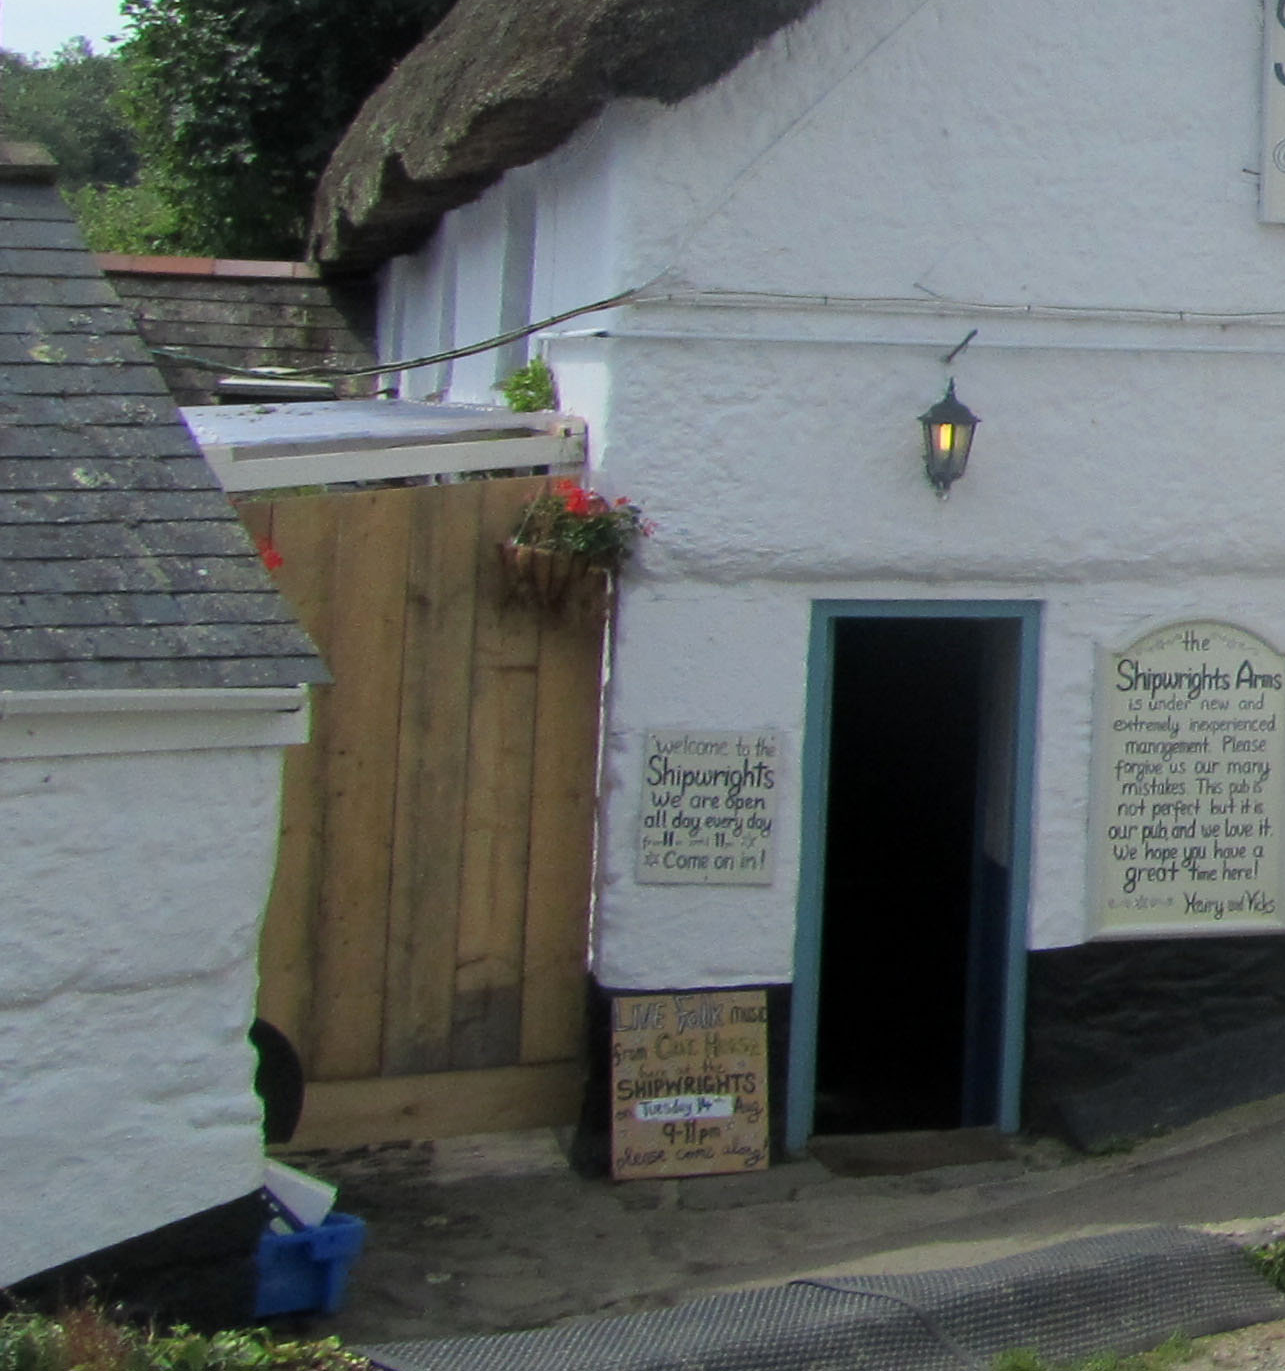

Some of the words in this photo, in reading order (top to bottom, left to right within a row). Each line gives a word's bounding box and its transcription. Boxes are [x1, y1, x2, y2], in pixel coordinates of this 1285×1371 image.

[1182, 630, 1211, 652] the
[1116, 658, 1231, 700] Shipwrights
[1235, 659, 1282, 690] Arms
[1128, 698, 1142, 711] is
[1148, 693, 1191, 711] under
[1200, 699, 1229, 711] new
[1238, 692, 1264, 710] and
[1113, 716, 1179, 739] extremely
[736, 737, 750, 756] to
[1222, 735, 1266, 752] Please
[646, 754, 775, 797] Shipwrights
[1115, 759, 1163, 781] forgive
[1170, 762, 1185, 773] us
[1194, 761, 1220, 773] our
[1226, 761, 1271, 782] many
[1195, 778, 1223, 795] This
[1229, 778, 1249, 797] pub
[1252, 780, 1263, 793] is
[689, 795, 720, 809] are
[725, 795, 765, 814] open
[1118, 799, 1145, 816] not
[1152, 799, 1200, 822] perfect
[1210, 799, 1234, 815] but
[1240, 800, 1253, 814] it
[644, 810, 667, 828] all
[672, 811, 702, 836] day
[705, 812, 743, 837] every
[747, 813, 772, 837] day
[1108, 826, 1136, 839] our
[1171, 819, 1196, 838] and
[1201, 824, 1220, 836] we
[1225, 819, 1254, 836] love
[663, 850, 710, 869] Come
[714, 856, 734, 870] on
[740, 850, 766, 870] in!
[1113, 844, 1137, 860] We
[1145, 842, 1178, 864] hope
[1181, 846, 1206, 868] you
[1214, 839, 1247, 859] have
[1253, 845, 1264, 859] a
[1123, 862, 1179, 893] great
[1187, 863, 1217, 881] time
[1222, 860, 1258, 881] here!
[616, 1073, 756, 1100] SHIPWRIGHTS
[639, 1099, 692, 1116] Tuesday
